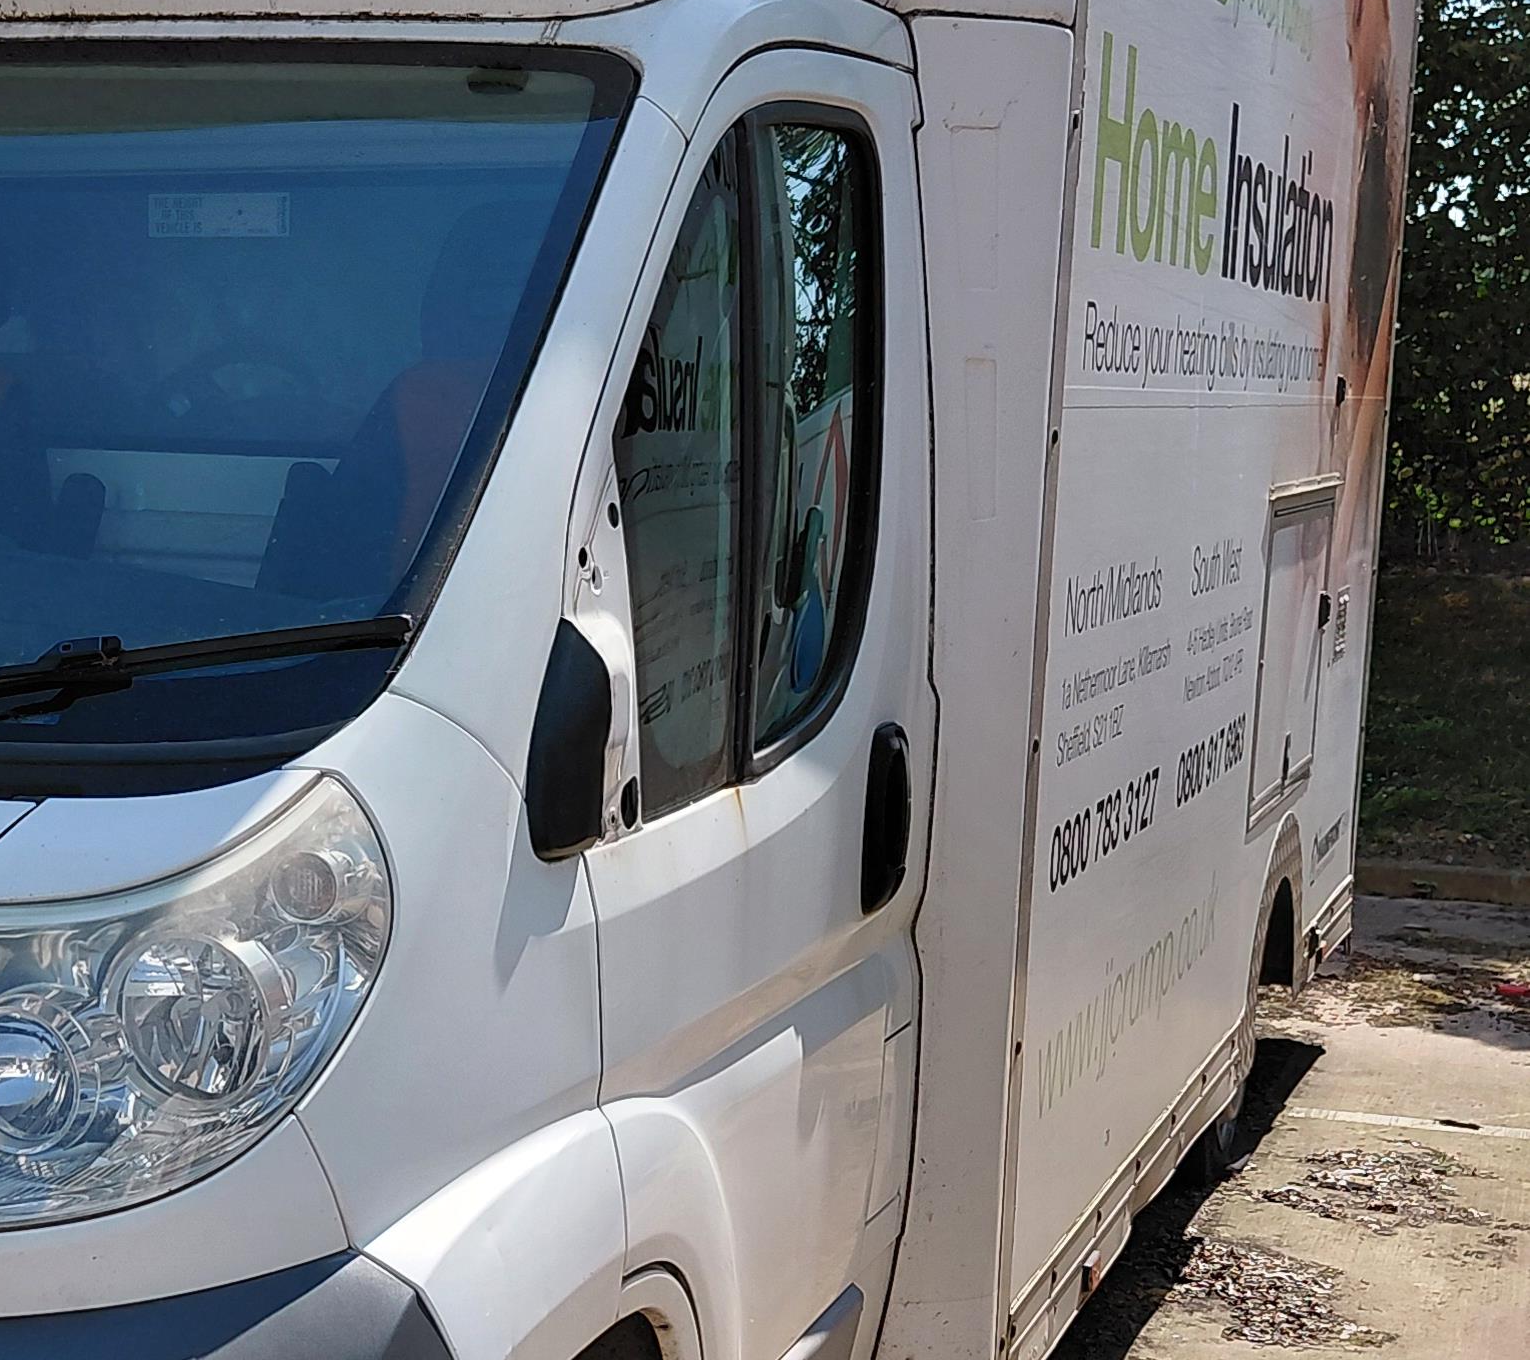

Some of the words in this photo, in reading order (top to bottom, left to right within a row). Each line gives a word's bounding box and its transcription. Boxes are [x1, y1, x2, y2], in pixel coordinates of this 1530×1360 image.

[1090, 31, 1218, 278] Home
[1221, 102, 1334, 304] Insulation
[1082, 300, 1142, 372] Reduce
[1141, 323, 1174, 390] your
[1173, 313, 1218, 392] heating
[1191, 542, 1220, 597] South
[1220, 538, 1243, 587] West
[1176, 740, 1206, 808] 0800
[1206, 727, 1225, 788] 917
[1049, 807, 1091, 893] 0800
[1094, 788, 1121, 863] 783
[1123, 766, 1160, 842] 3127
[1038, 870, 1220, 1120] www.jjcrump.co.uk
